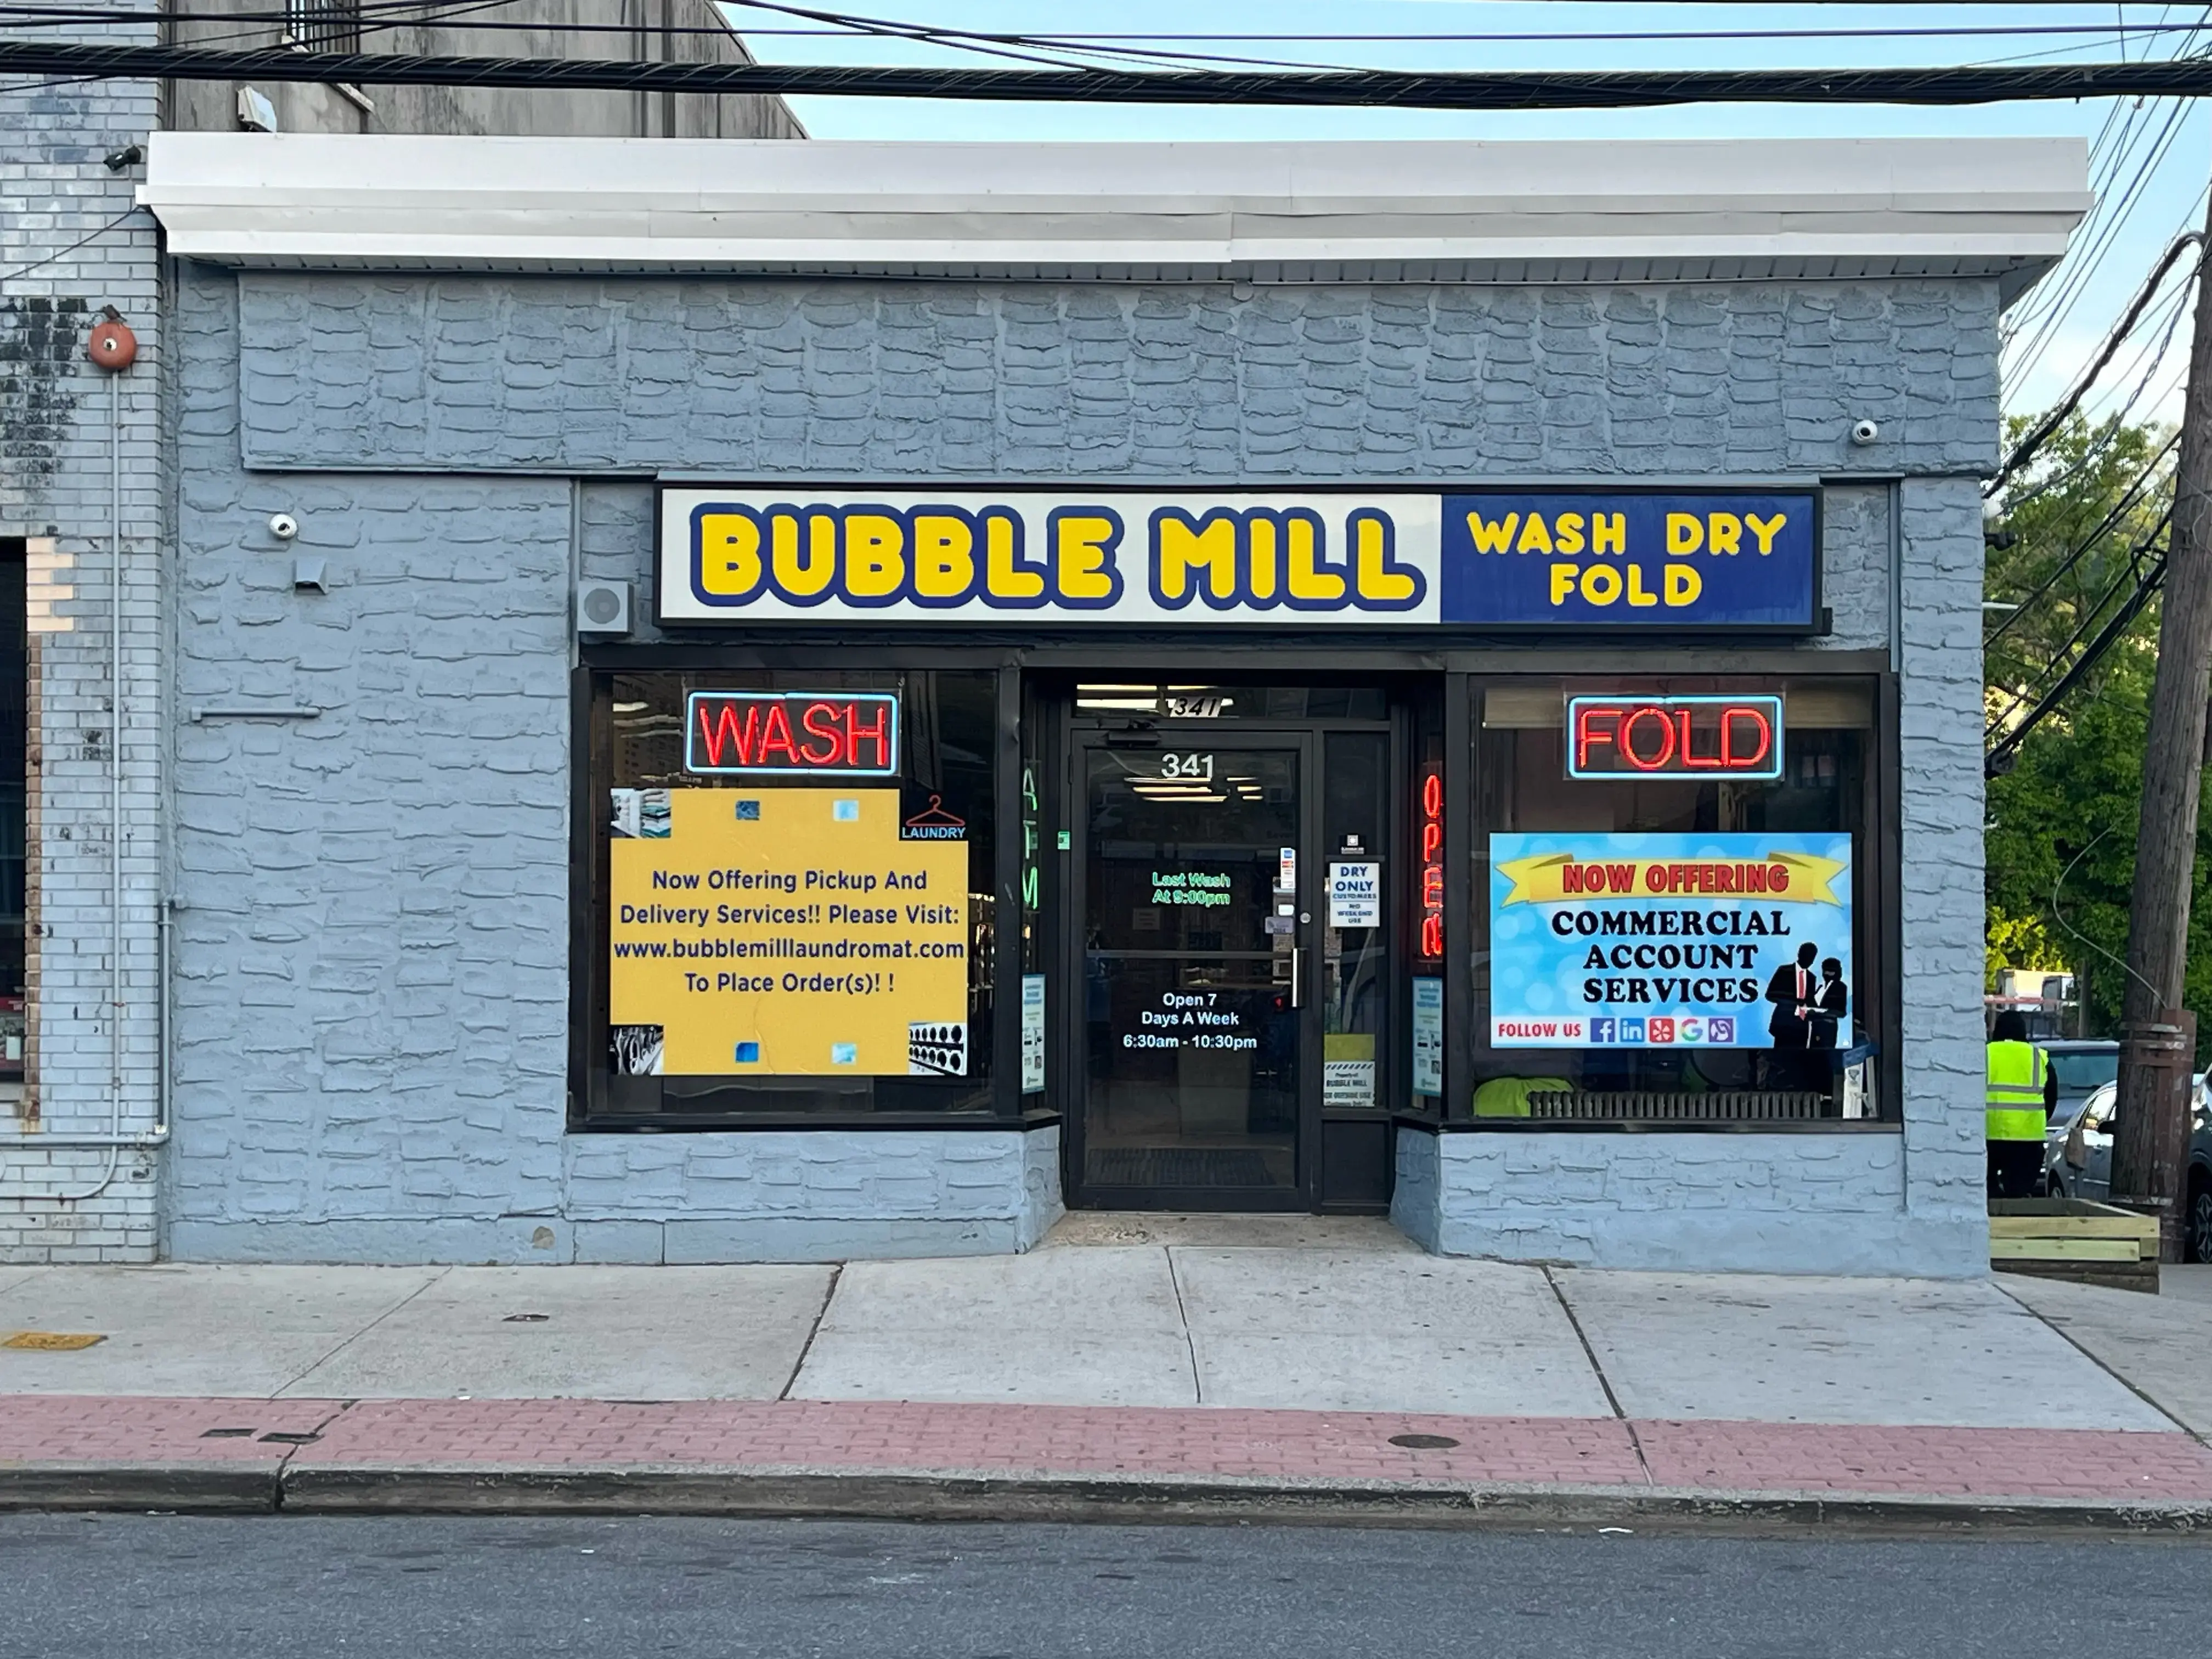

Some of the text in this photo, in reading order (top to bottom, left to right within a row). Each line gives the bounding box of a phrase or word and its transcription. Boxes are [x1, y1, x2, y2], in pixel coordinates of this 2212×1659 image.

[1467, 512, 1787, 555] WASH DRY
[697, 509, 1419, 603] BUBBLE MILL
[1550, 563, 1703, 606] FOLD
[1174, 697, 1217, 716] 341
[699, 703, 888, 766] WASH
[1579, 708, 1770, 771] FOLD
[1161, 753, 1214, 778] 341
[901, 826, 966, 839] LAUNDRY
[1022, 768, 1038, 910] ATM
[1340, 866, 1368, 877] DRY
[1423, 775, 1443, 956] OPEN
[1562, 863, 1790, 893] NOW OFFERING
[652, 868, 927, 894] Now Offering Pickup And
[1152, 871, 1231, 887] Last Wash
[1335, 881, 1374, 892] ONLY
[1152, 888, 1172, 904] At
[620, 903, 960, 928] Delivery Services!! Please Visit:
[1551, 910, 1791, 936] COMMERCIAL
[613, 937, 964, 960] www.bubblemilllaundromat.com
[1582, 943, 1759, 970] ACCOUNT
[684, 972, 710, 993] To
[717, 972, 774, 993] Place
[1583, 977, 1759, 1004] SERVICES
[1163, 992, 1218, 1009] Open 7
[1141, 1011, 1240, 1028] Days A Week
[1498, 1023, 1582, 1037] FOLLOW US
[1122, 1034, 1180, 1048] 6:30am
[1191, 1034, 1257, 1051] 10:30pm
